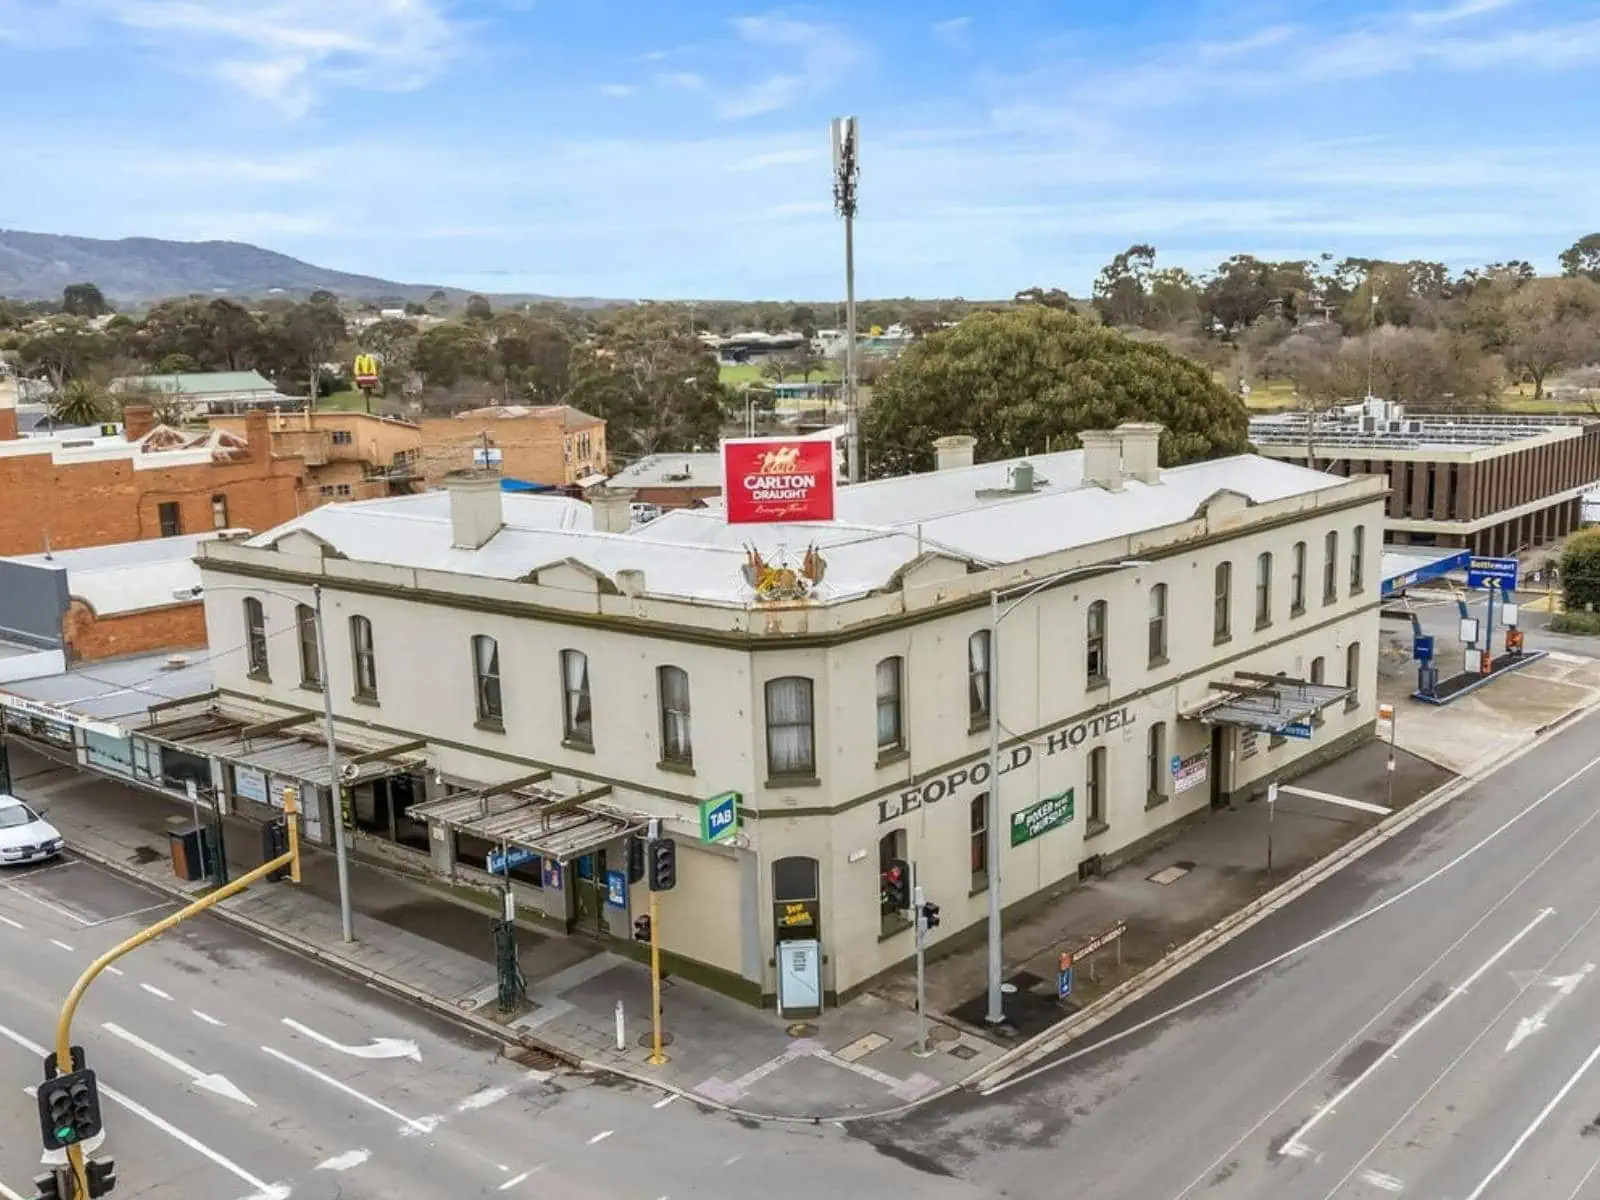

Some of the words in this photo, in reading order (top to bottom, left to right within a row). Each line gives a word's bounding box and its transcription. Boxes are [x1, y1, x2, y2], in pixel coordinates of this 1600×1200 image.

[743, 475, 816, 489] CARLTON
[752, 489, 808, 499] DRAUGHT
[878, 745, 1033, 824] LEOPOLD
[1046, 707, 1136, 756] HOTEL
[710, 809, 732, 828] TAB
